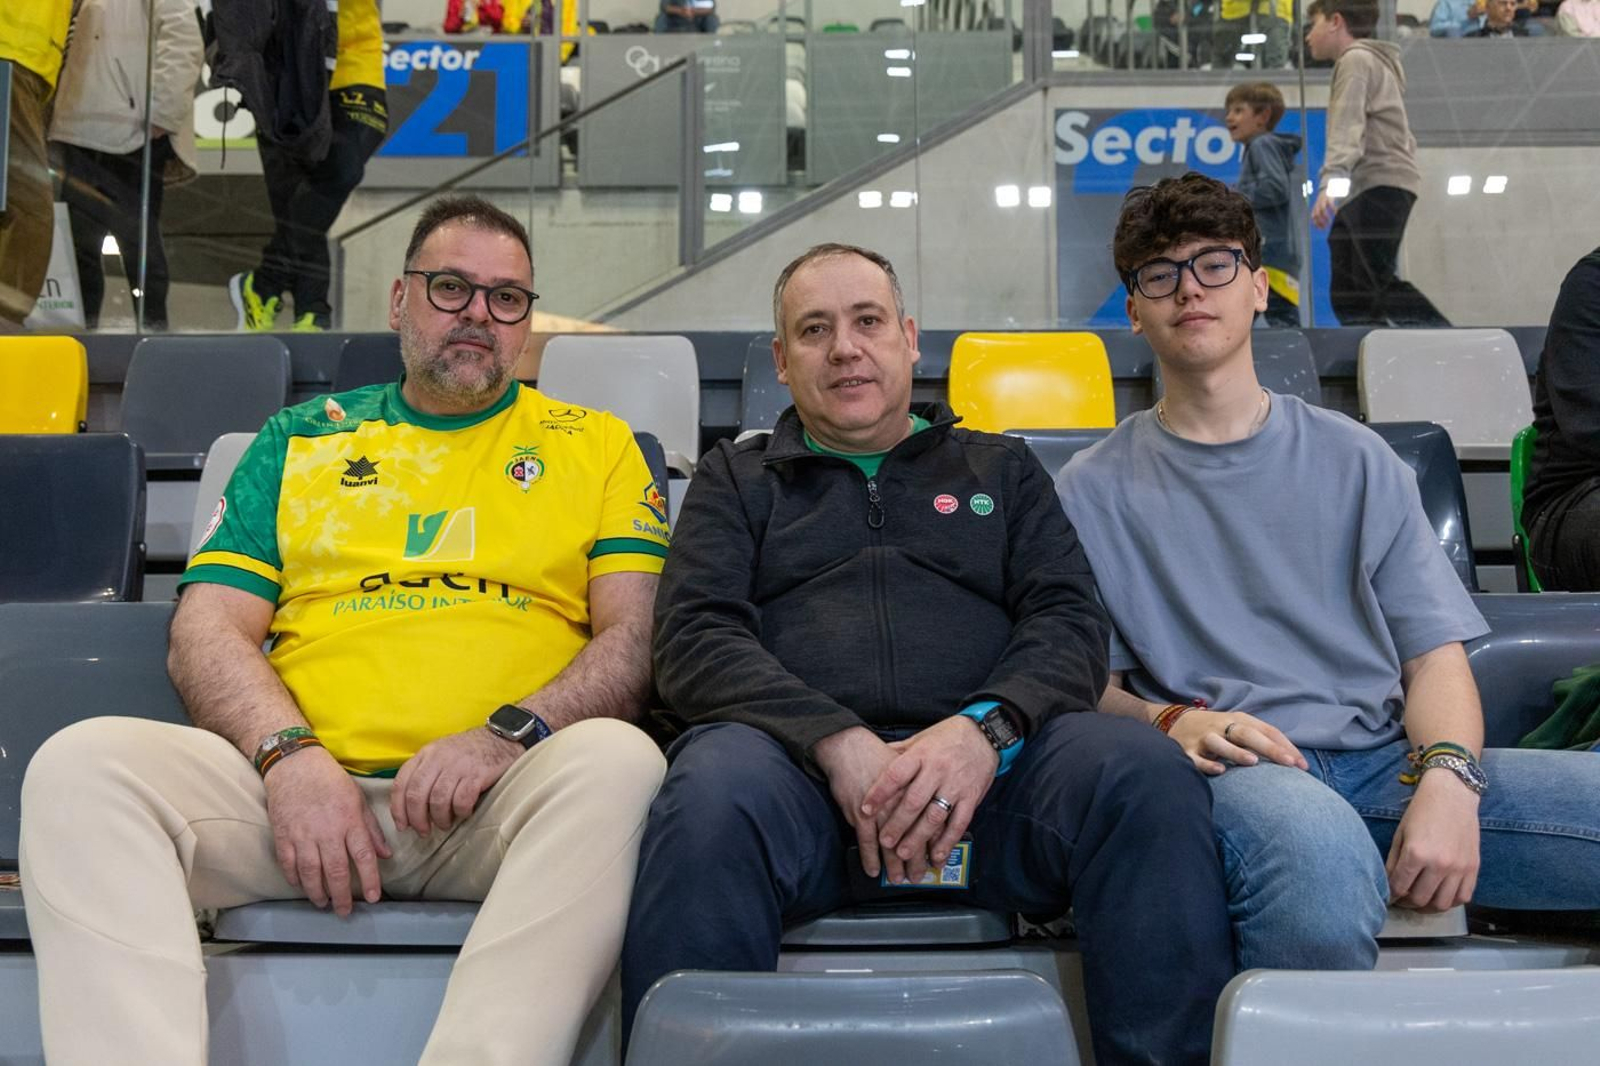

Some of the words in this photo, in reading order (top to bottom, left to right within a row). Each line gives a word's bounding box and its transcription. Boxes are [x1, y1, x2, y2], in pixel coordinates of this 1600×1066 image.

[378, 42, 529, 156] 21
[1055, 111, 1244, 165] Secto
[340, 477, 378, 487] luanvi
[333, 589, 425, 615] PARAÍSO
